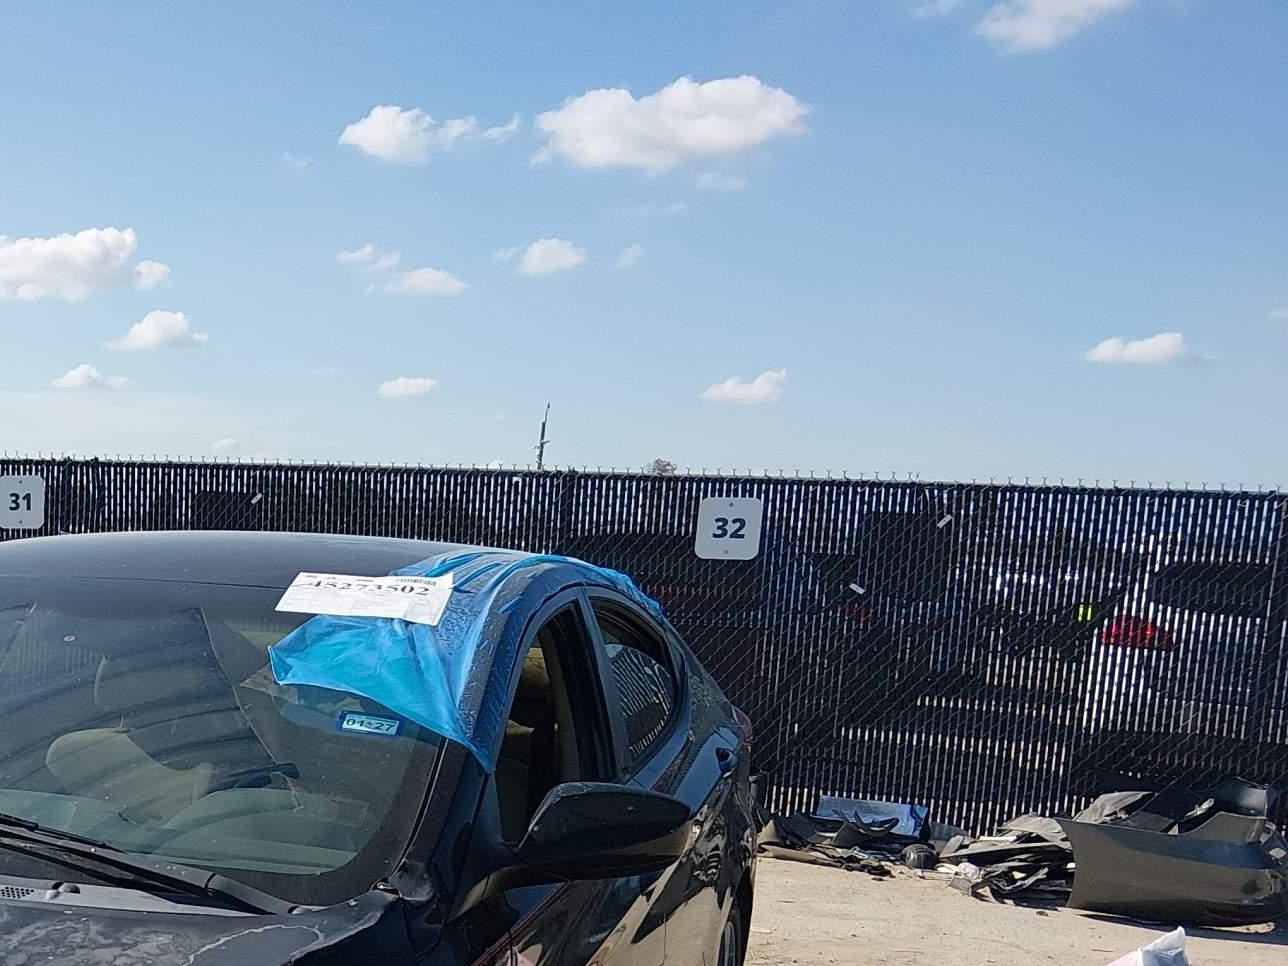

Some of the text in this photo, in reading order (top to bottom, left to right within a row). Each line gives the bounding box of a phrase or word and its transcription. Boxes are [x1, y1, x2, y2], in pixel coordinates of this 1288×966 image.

[8, 492, 32, 512] 31
[712, 517, 746, 538] 32
[310, 580, 430, 596] 45273502
